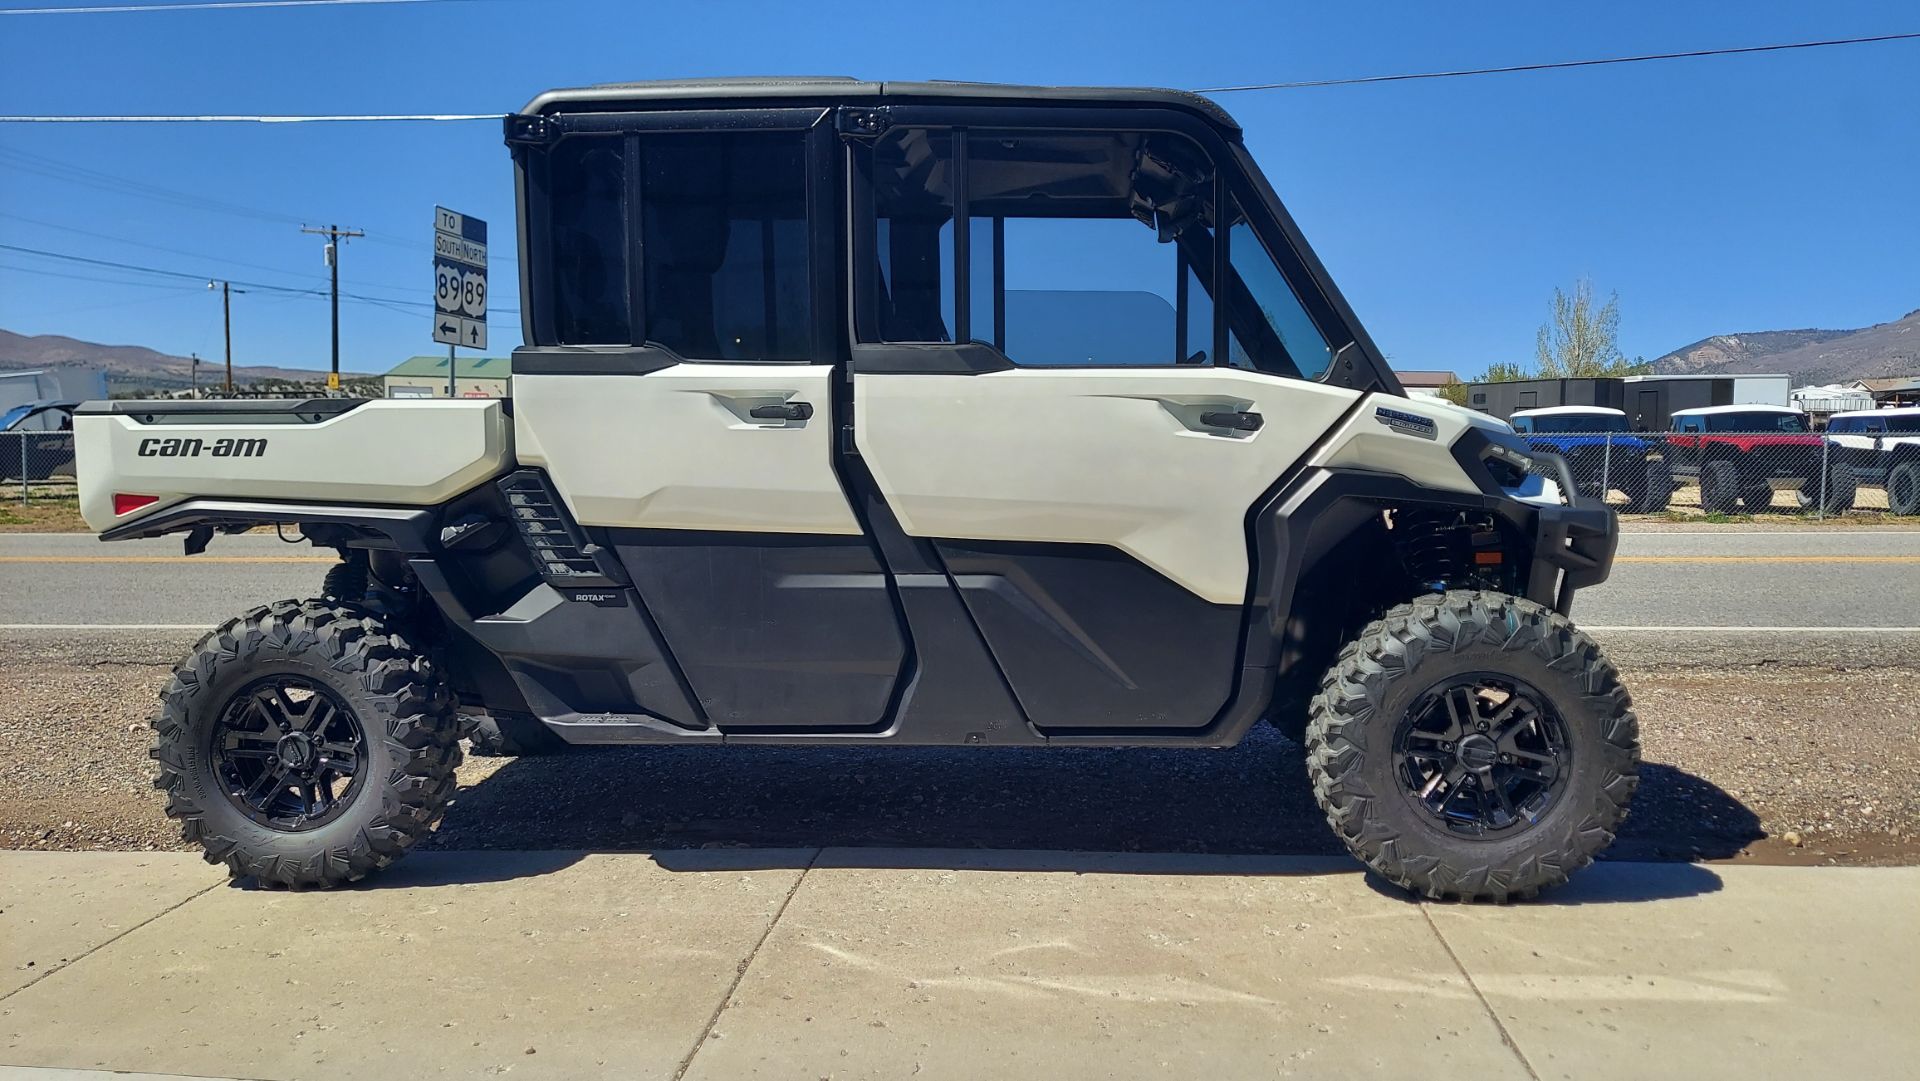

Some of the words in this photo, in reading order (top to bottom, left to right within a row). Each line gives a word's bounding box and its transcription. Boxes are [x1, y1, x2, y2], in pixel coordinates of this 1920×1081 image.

[443, 213, 456, 229] TO
[437, 236, 461, 255] SOUTH
[464, 243, 487, 263] NORTH
[438, 273, 460, 301] 89
[465, 281, 485, 307] 89
